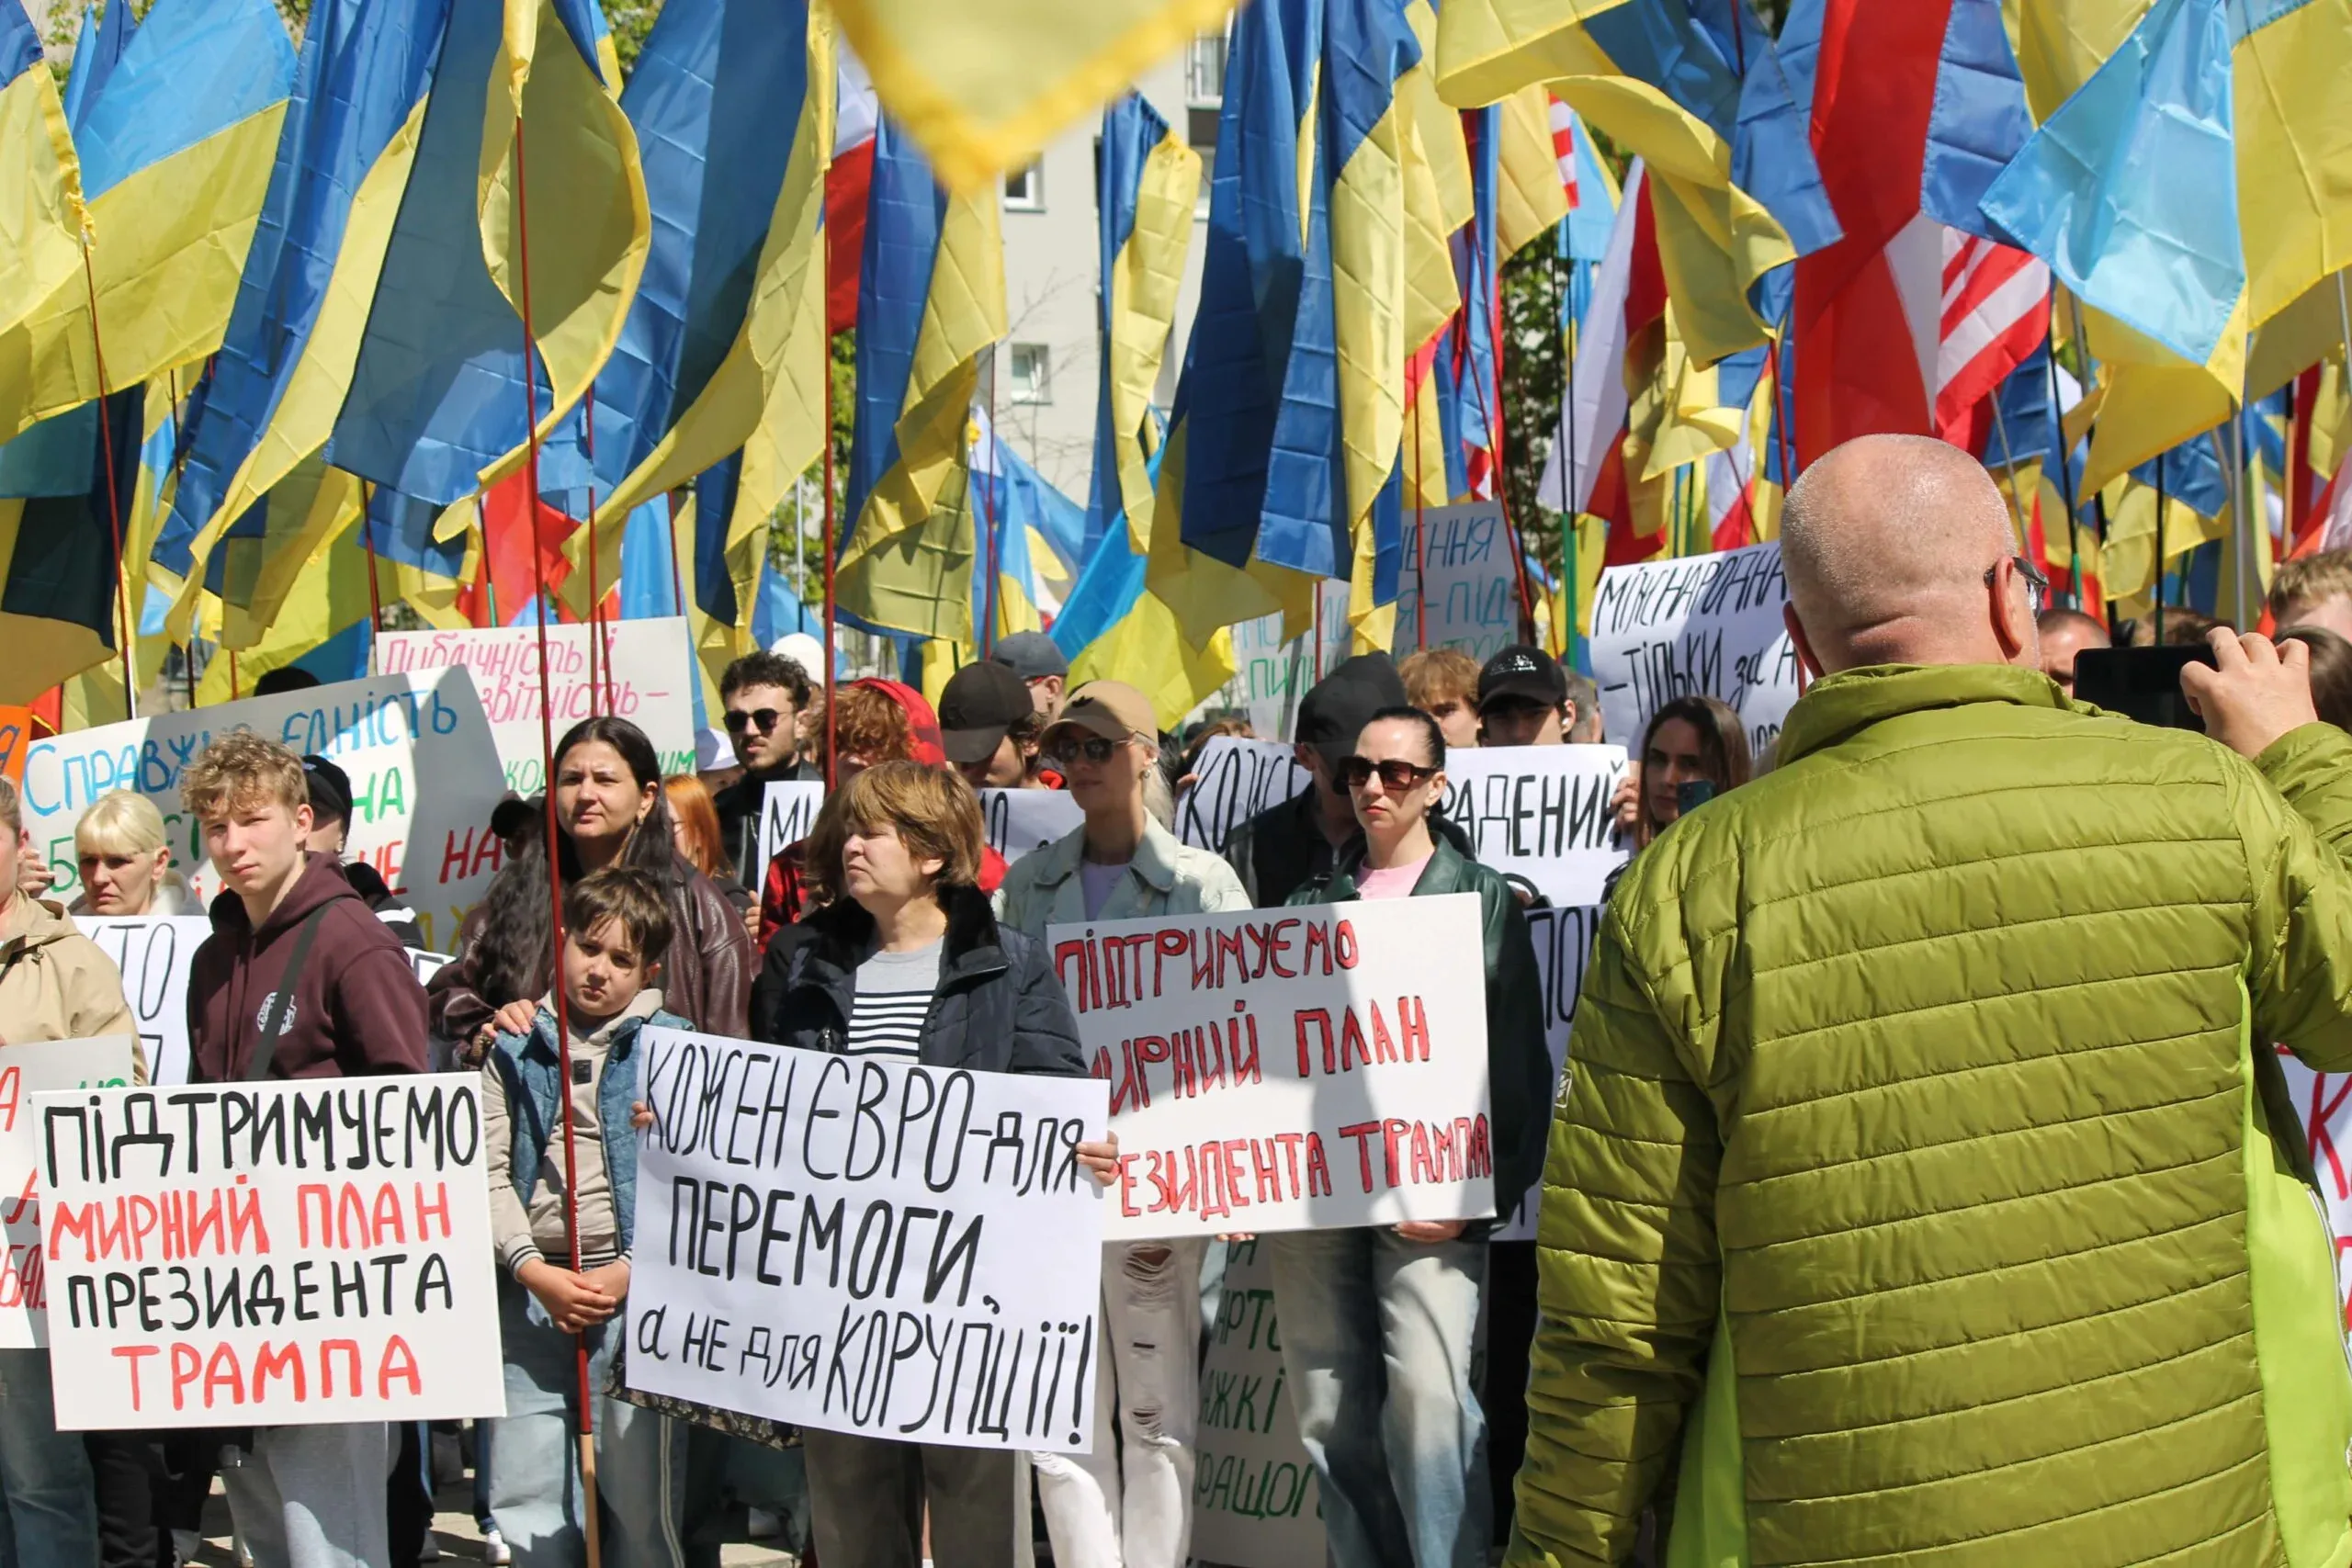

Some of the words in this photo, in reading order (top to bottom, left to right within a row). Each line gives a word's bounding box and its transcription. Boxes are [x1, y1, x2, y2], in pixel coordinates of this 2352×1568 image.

[1445, 573, 1510, 629] ПІД
[23, 722, 253, 817] СПРАВЖ
[281, 690, 458, 761] ЄДНІСТЬ
[92, 922, 176, 1022] ТО
[1054, 919, 1360, 1014] ПІДТРИМУЄМО
[1294, 995, 1430, 1078] ПЛАН
[43, 1084, 479, 1188] ПІДТРИМУЄМО
[646, 1039, 797, 1170] КОЖЕН
[1118, 1130, 1333, 1222] ЕЗИДЕНТА
[1338, 1111, 1492, 1194] ТРАМПА
[49, 1174, 271, 1263] МИРНИЙ
[297, 1180, 453, 1252] ПЛАН
[67, 1252, 454, 1332] ПРЕЗИДЕНТА
[111, 1334, 423, 1411] ТРАМПА
[682, 1318, 729, 1373] НЕ
[1193, 1449, 1325, 1521] РАЩО
